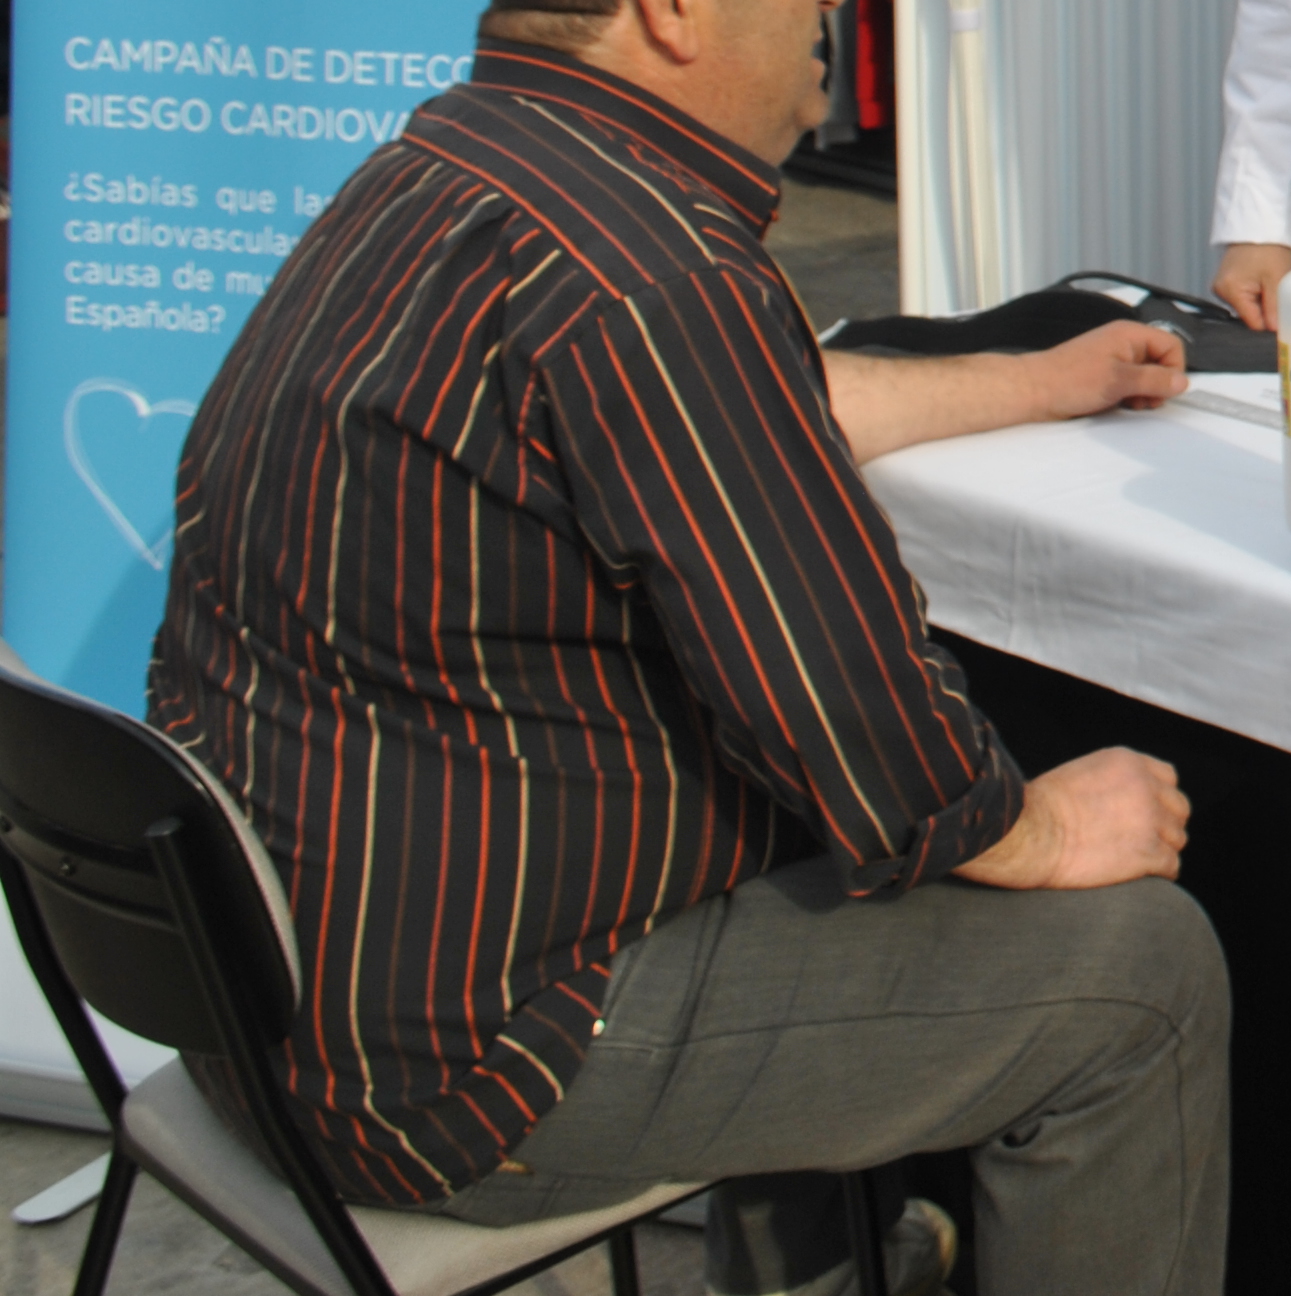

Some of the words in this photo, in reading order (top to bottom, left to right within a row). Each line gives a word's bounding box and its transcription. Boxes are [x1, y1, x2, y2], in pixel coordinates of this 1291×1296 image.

[65, 36, 259, 80] CAMPAÑA
[265, 46, 315, 83] DE
[65, 92, 212, 133] RIESGO
[64, 173, 198, 209] ¿Sabías
[217, 188, 277, 221] que
[294, 186, 335, 217] la
[64, 216, 300, 258] cardiovascula
[64, 261, 161, 289] causa
[172, 260, 214, 293] de
[65, 295, 226, 334] Española?
